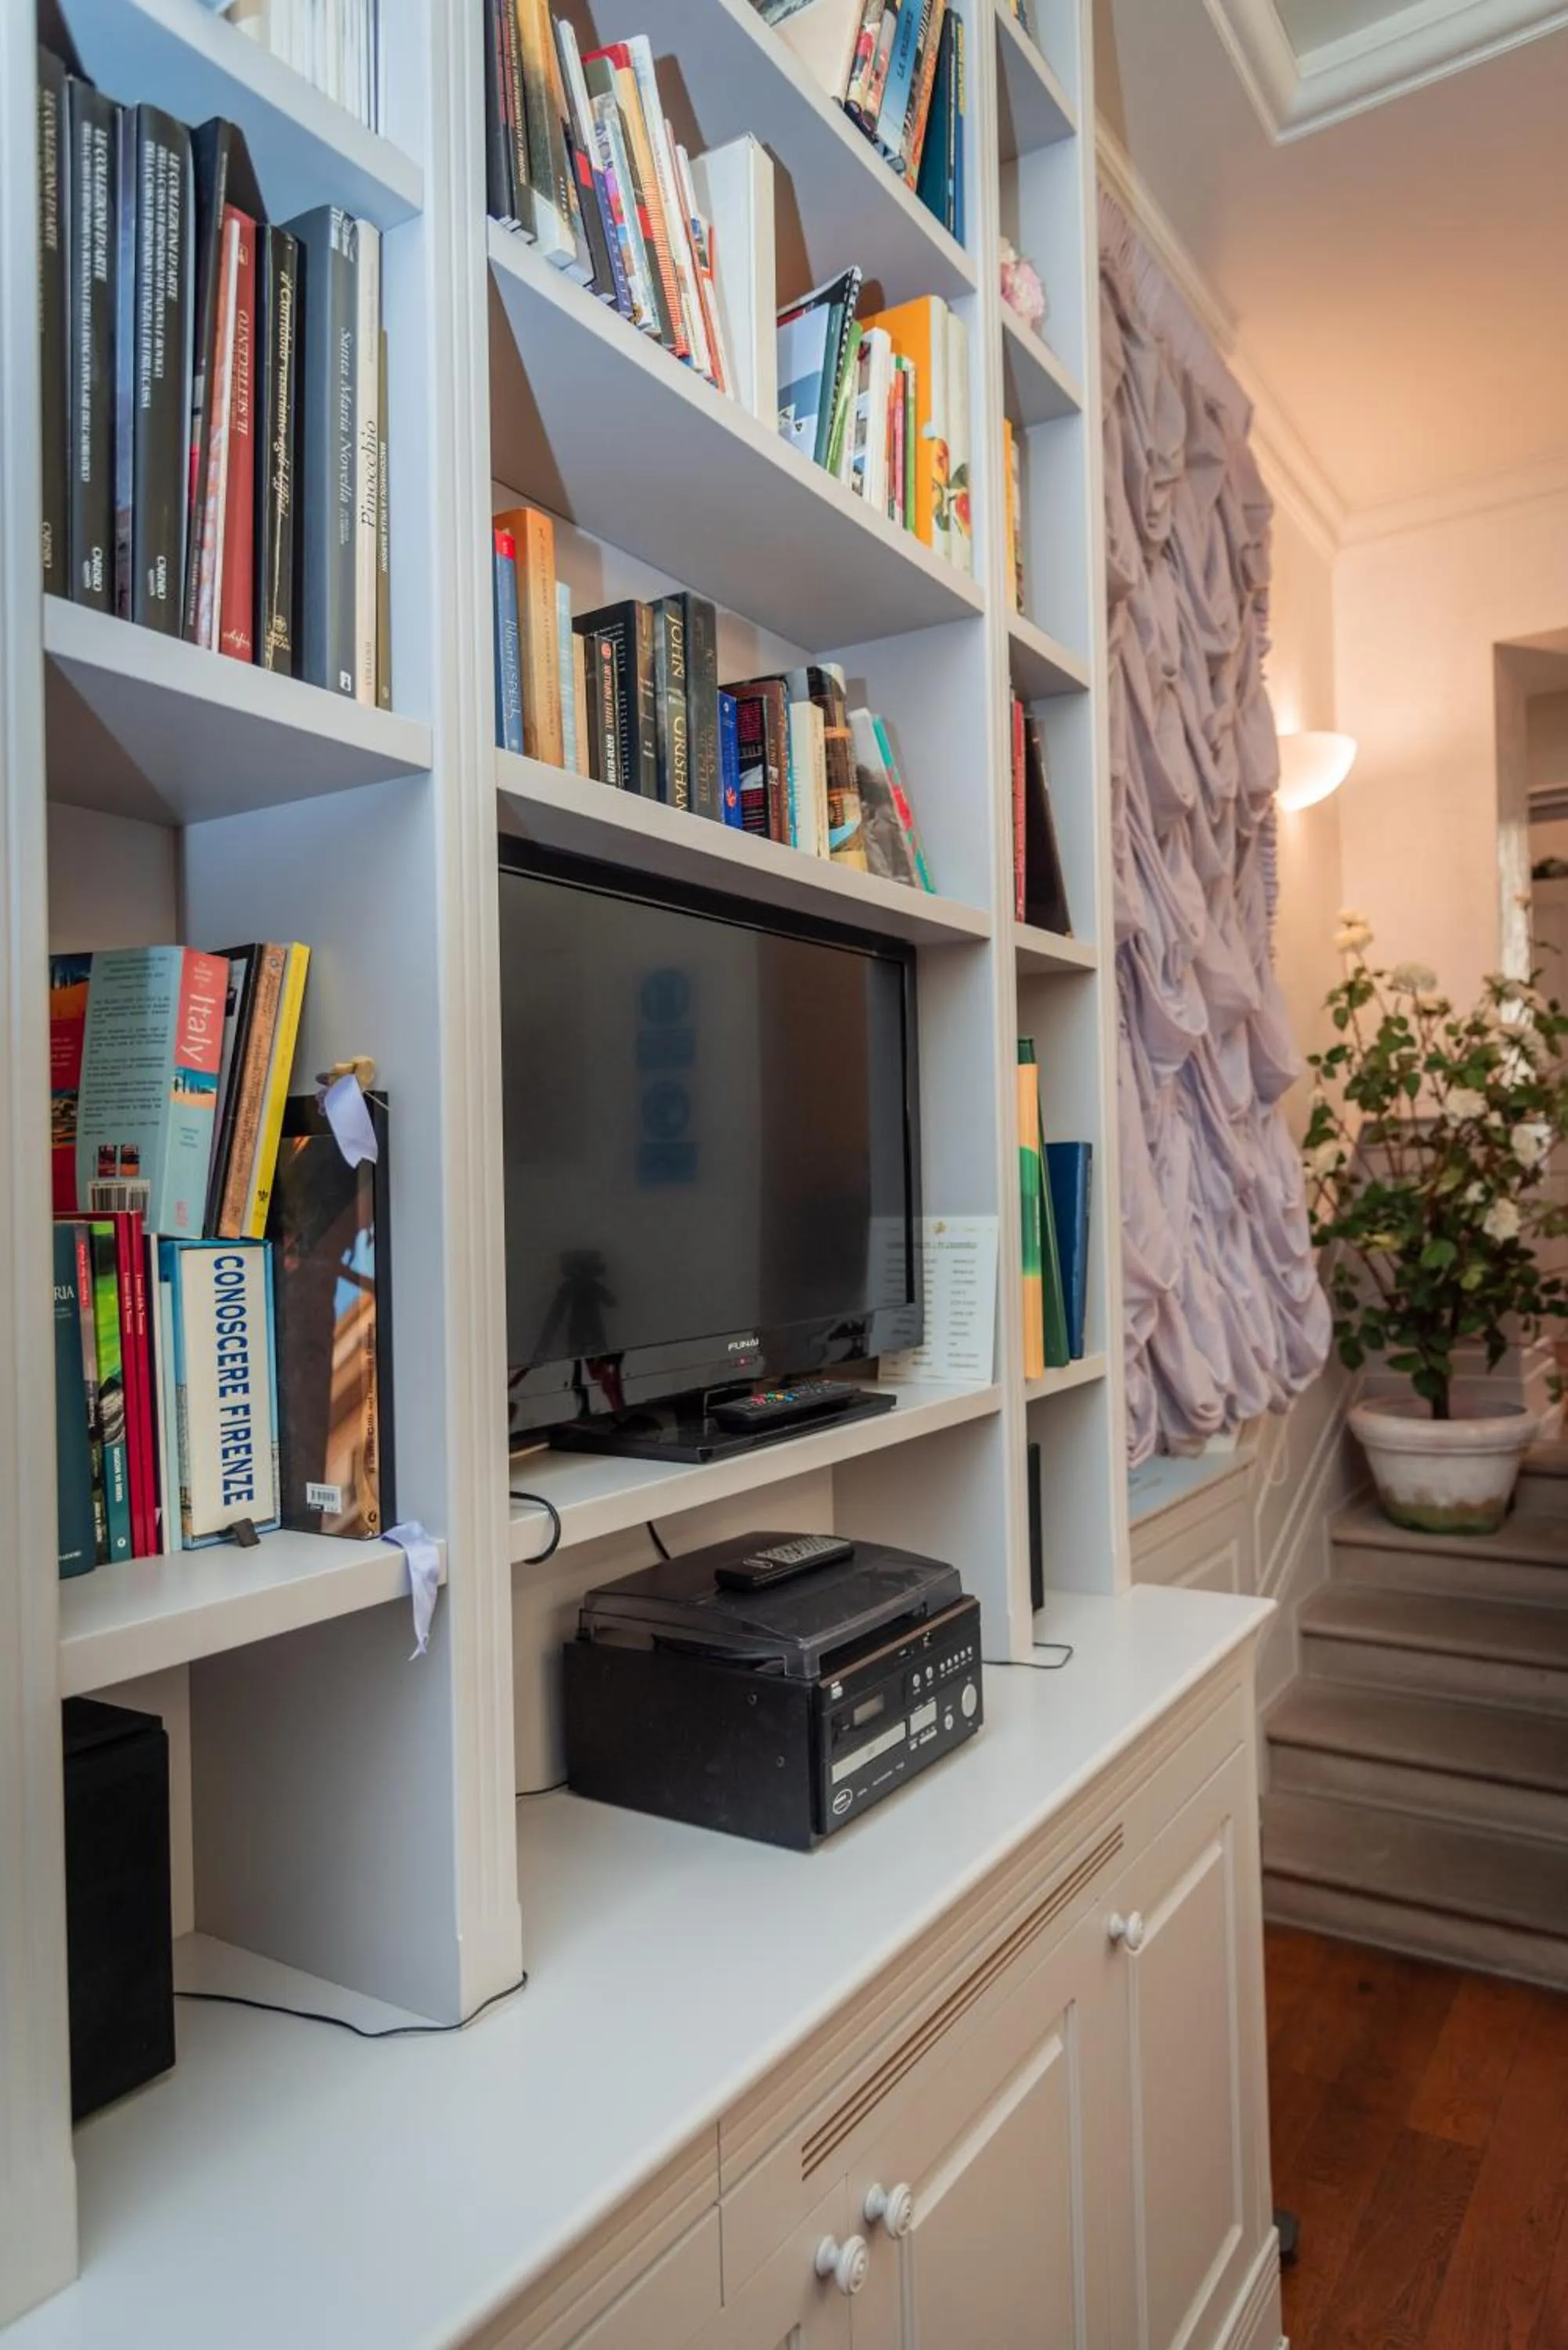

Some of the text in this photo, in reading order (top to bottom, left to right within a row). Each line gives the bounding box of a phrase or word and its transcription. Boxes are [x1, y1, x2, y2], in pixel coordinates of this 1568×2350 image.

[94, 128, 107, 281] LE COLLEZIONI D'ARTE
[166, 152, 180, 302] LE COLLEZIONI D'ARTE
[279, 287, 293, 362] Corridoio
[340, 327, 352, 376] Santa
[237, 309, 249, 436] IL SETTECENTO
[340, 379, 352, 432] Maria
[339, 436, 352, 504] Novella
[359, 420, 377, 527] Pinocchio
[665, 613, 685, 680] JOHN
[180, 992, 216, 1063] Italy
[214, 1256, 255, 1506] CONOSCERE FIRENZE
